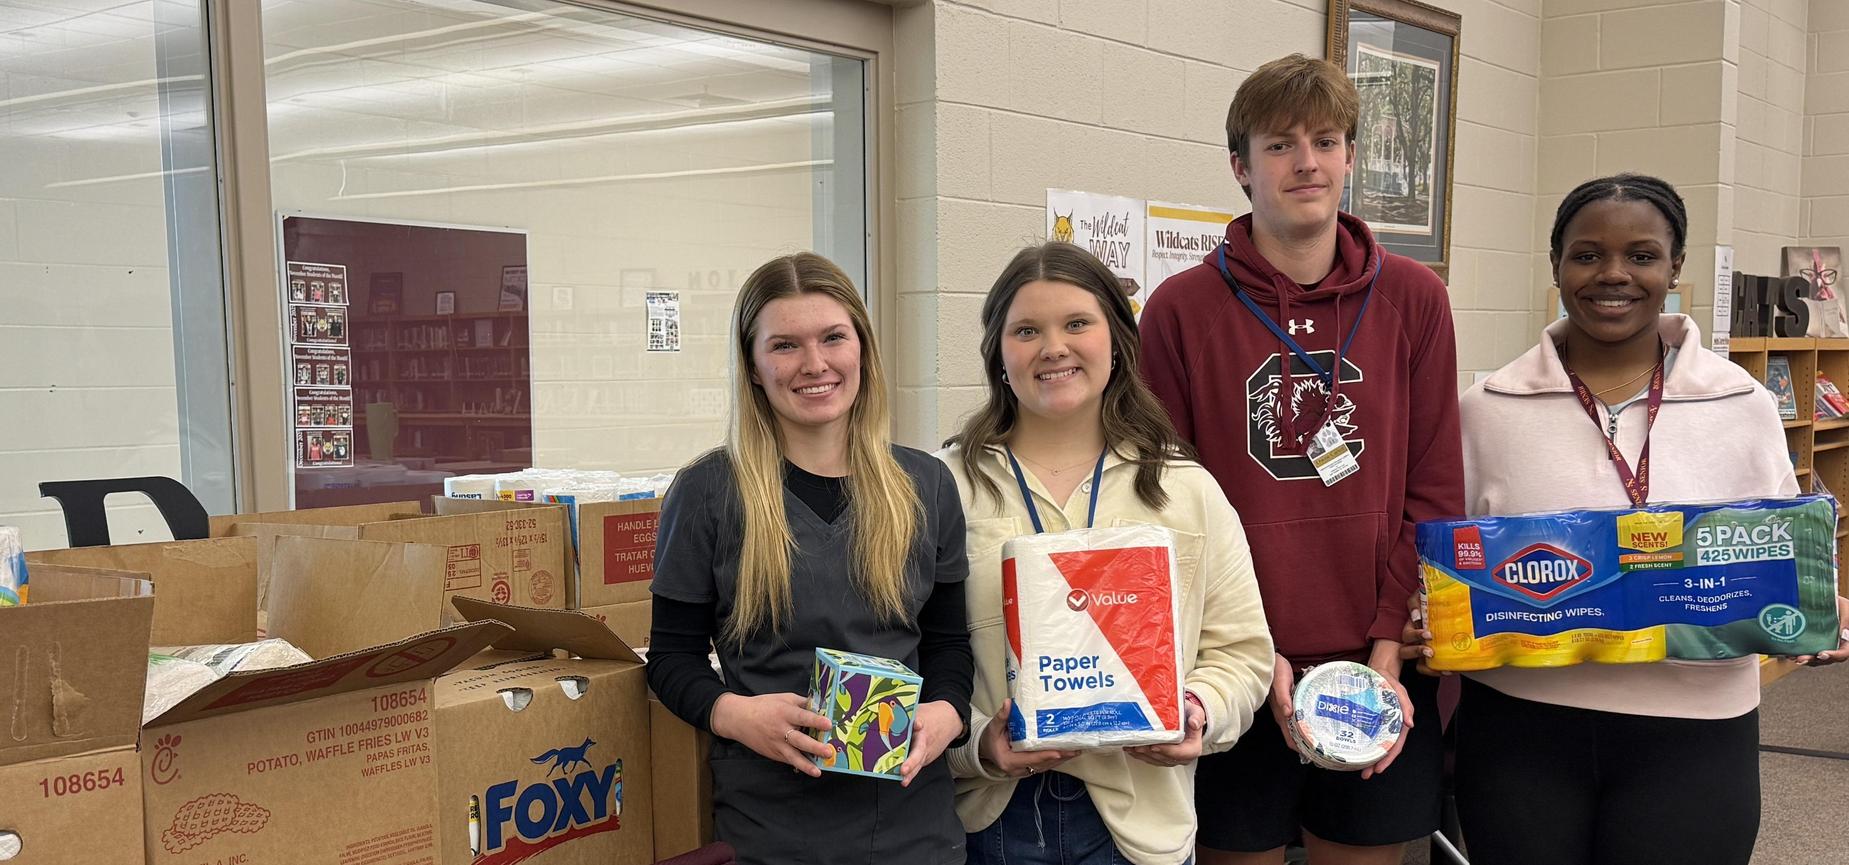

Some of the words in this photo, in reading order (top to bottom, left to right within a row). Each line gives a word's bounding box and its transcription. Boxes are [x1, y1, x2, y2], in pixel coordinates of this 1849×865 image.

[1080, 219, 1092, 231] The
[1092, 212, 1129, 239] Wildcat
[1155, 230, 1199, 251] Wildcats
[1089, 239, 1131, 268] WAY
[1189, 252, 1204, 262] Streng
[1730, 271, 1811, 338] CATS
[617, 520, 652, 532] HANDLE
[1696, 527, 1713, 547] 5
[1716, 520, 1793, 545] PACK
[1631, 532, 1668, 541] NEW
[615, 550, 648, 562] TRATAR
[1458, 550, 1482, 558] 99.9%
[1700, 548, 1731, 562] 425
[1735, 543, 1791, 560] WIPES
[628, 563, 653, 574] HUEV
[1504, 559, 1580, 584] CLOROX
[1684, 576, 1726, 589] 3-IN-1
[1091, 592, 1138, 607] Value
[1659, 595, 1696, 603] CLEANS,
[1697, 589, 1752, 603] DEODORIZES,
[1486, 610, 1563, 623] DISINFECTING
[1685, 603, 1728, 612] FRESHENS
[1039, 655, 1100, 674] Paper
[1039, 671, 1115, 692] Towels
[371, 687, 427, 713] 108654
[306, 726, 336, 744] GTIN
[338, 709, 428, 737] 10044979000682
[1046, 713, 1055, 725] 2
[1339, 730, 1354, 739] 32
[247, 754, 303, 775] POTATO,
[305, 744, 355, 763] WAFFLE
[358, 735, 392, 754] FRIES
[395, 730, 412, 746] LW
[414, 726, 429, 742] V3
[366, 749, 394, 763] PAPAS
[397, 743, 430, 758] FRITAS,
[361, 761, 402, 778] WAFFLES
[404, 758, 418, 769] LW
[420, 754, 431, 765] V3
[39, 767, 125, 799] 108654
[486, 764, 617, 851] FOXY
